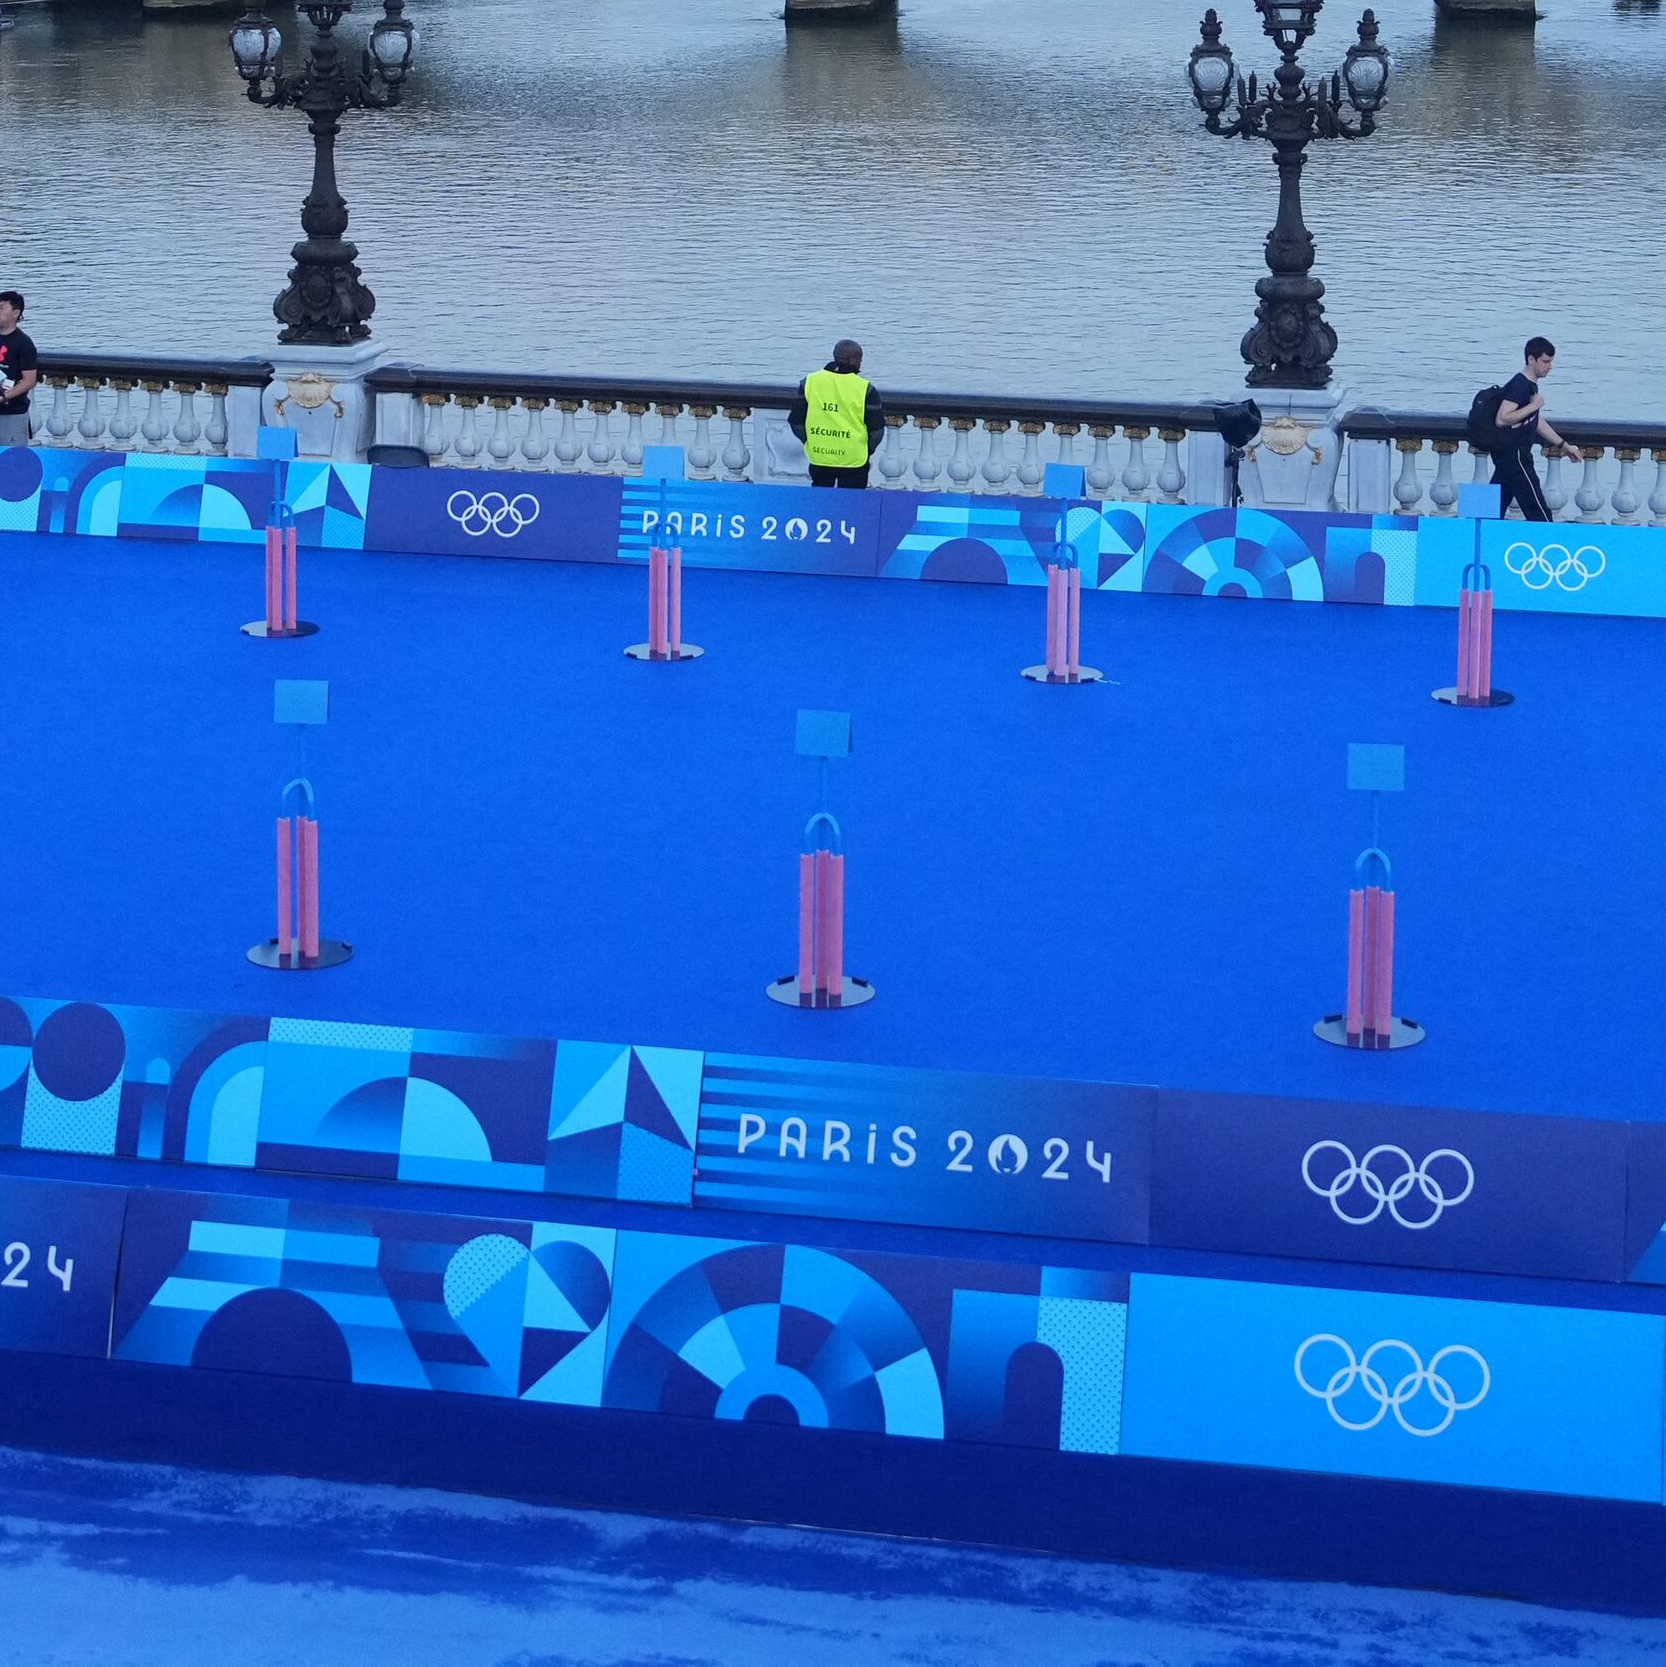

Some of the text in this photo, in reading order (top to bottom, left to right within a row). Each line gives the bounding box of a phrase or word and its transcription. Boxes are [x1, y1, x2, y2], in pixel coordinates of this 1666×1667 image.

[822, 402, 839, 412] 161
[810, 427, 851, 438] SÉCURITÉ
[812, 447, 846, 456] SECURITY
[761, 516, 856, 545] 2024
[946, 1130, 1112, 1184] 2024
